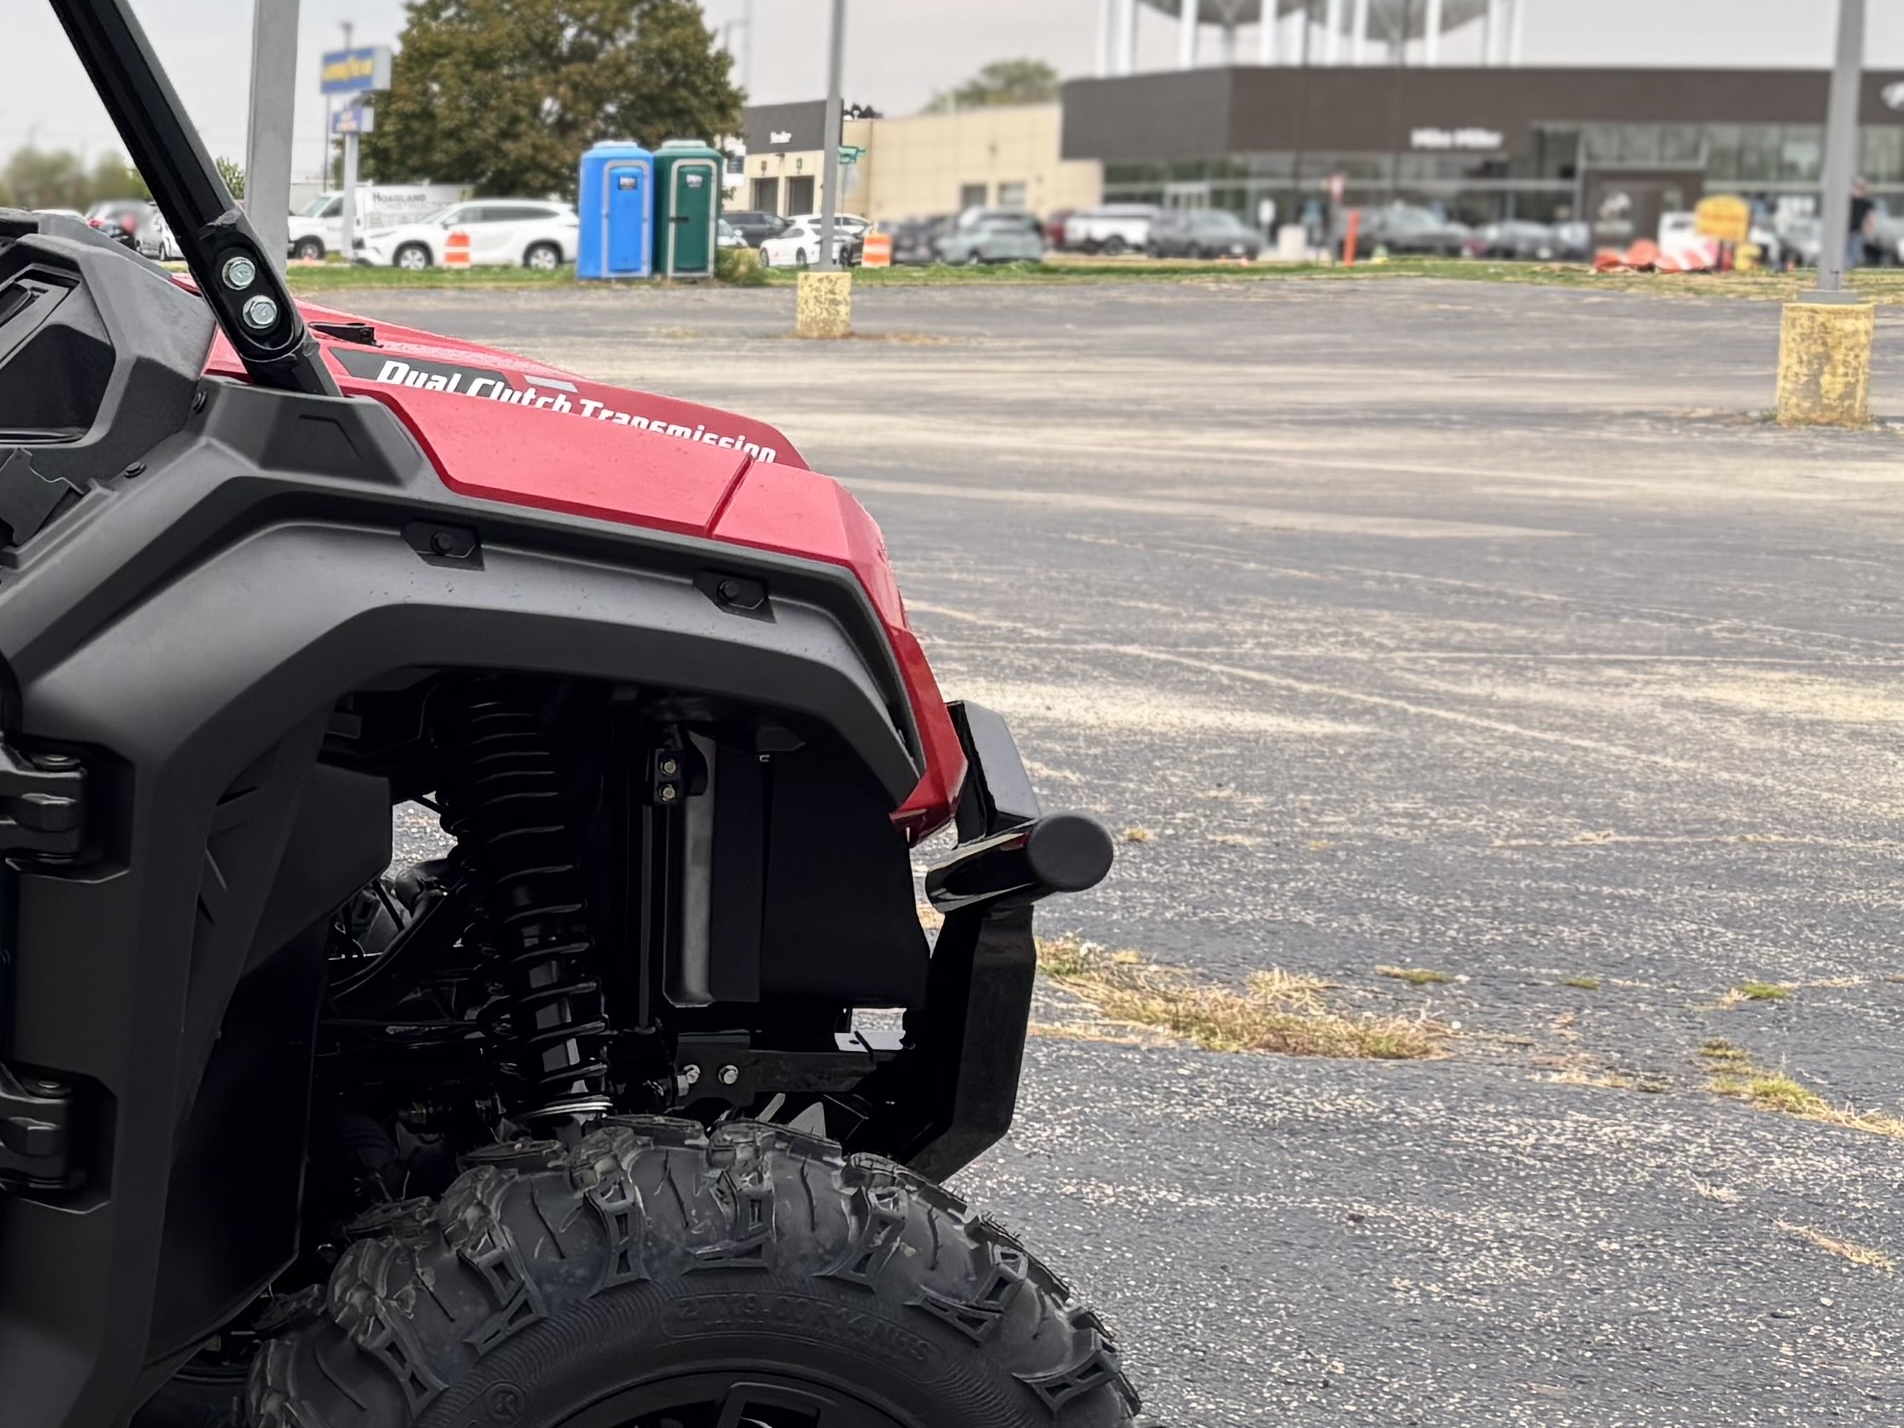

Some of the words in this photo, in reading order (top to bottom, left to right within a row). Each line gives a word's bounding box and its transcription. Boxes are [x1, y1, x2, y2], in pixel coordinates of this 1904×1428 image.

[376, 360, 462, 394] Dual
[466, 377, 571, 415] Clutch
[578, 398, 778, 464] Transmission
